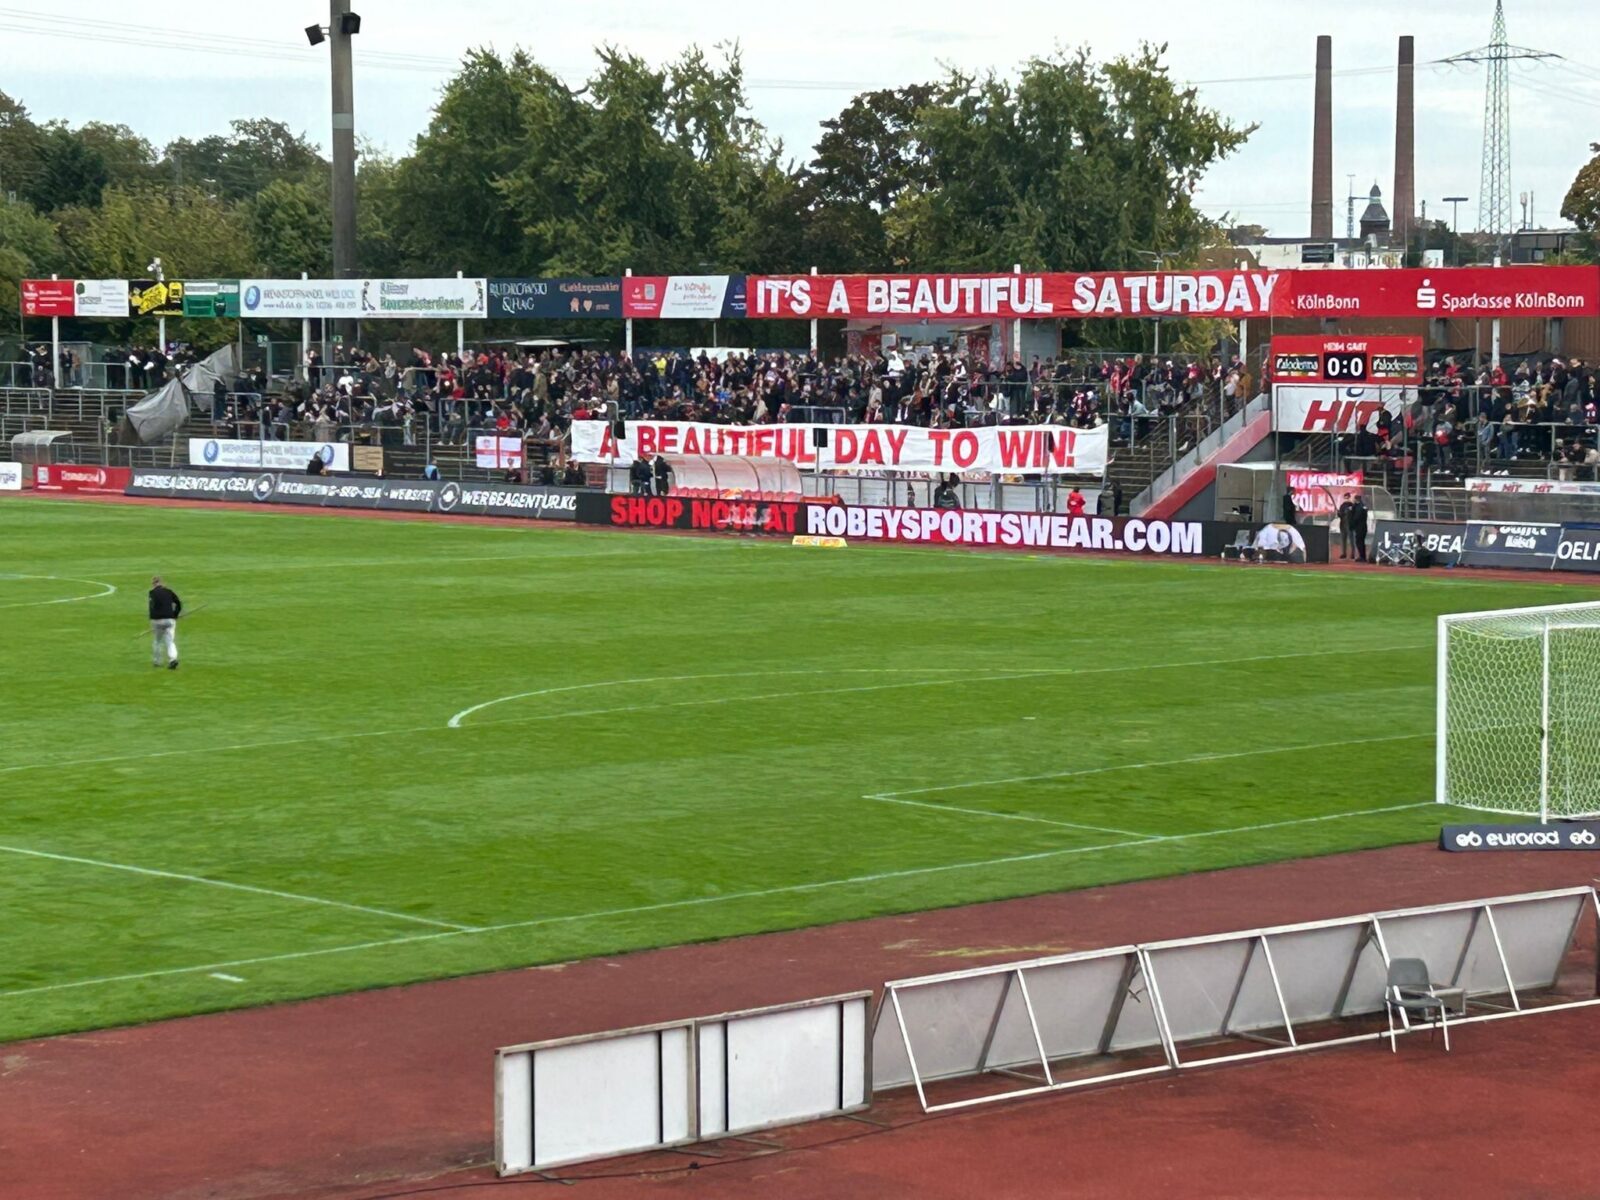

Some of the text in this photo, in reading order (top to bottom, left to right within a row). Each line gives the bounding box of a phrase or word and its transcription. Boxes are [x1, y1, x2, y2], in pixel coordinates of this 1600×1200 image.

[756, 279, 811, 315] IT'S
[827, 279, 850, 313] A
[867, 277, 1053, 314] BEAUTIFUL
[1072, 273, 1278, 314] SATURDAY
[1297, 294, 1360, 309] KölnBonn
[1442, 293, 1511, 310] Sparkasse
[1515, 292, 1584, 308] KölnBonn
[1327, 357, 1364, 376] 0:0
[1302, 400, 1386, 431] HIT
[598, 425, 1077, 468] A BEAUTIFUL DAY TO WIN!
[611, 496, 683, 526] SHOP
[765, 502, 798, 533] AT
[807, 504, 1203, 555] ROBEYSPORTSWEAR.COM
[1486, 830, 1560, 846] eurorad
